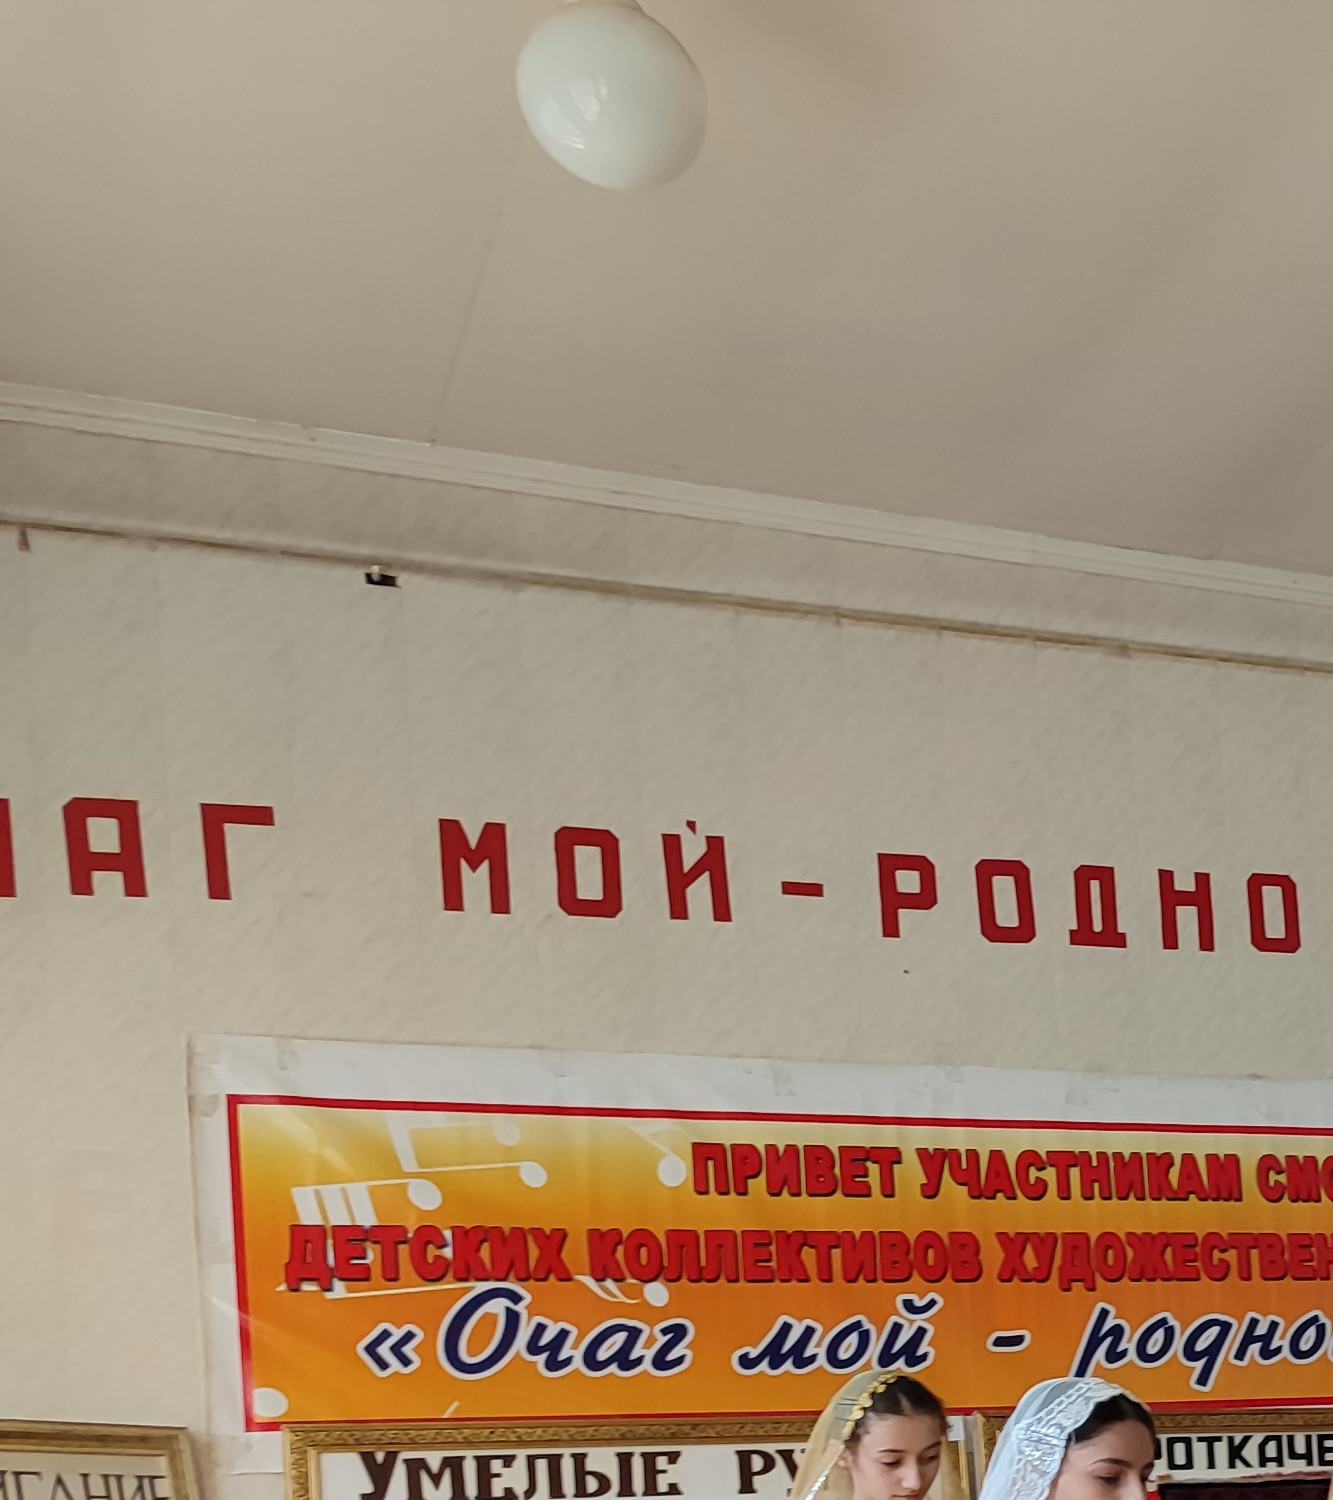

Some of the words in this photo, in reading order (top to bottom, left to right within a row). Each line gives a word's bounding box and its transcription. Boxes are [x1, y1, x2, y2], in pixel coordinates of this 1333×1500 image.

[0, 797, 275, 901] АГ
[439, 818, 732, 923] МОЙ
[692, 1142, 902, 1199] ПРИВЕТ
[918, 1147, 1243, 1203] УЧАСТНИКАМ
[284, 1223, 576, 1293] ДЕТСКИХ
[587, 1227, 984, 1284] КОЛЛЕКТИВОВ
[362, 1286, 690, 1376] «Очаг
[737, 1297, 939, 1372] мой
